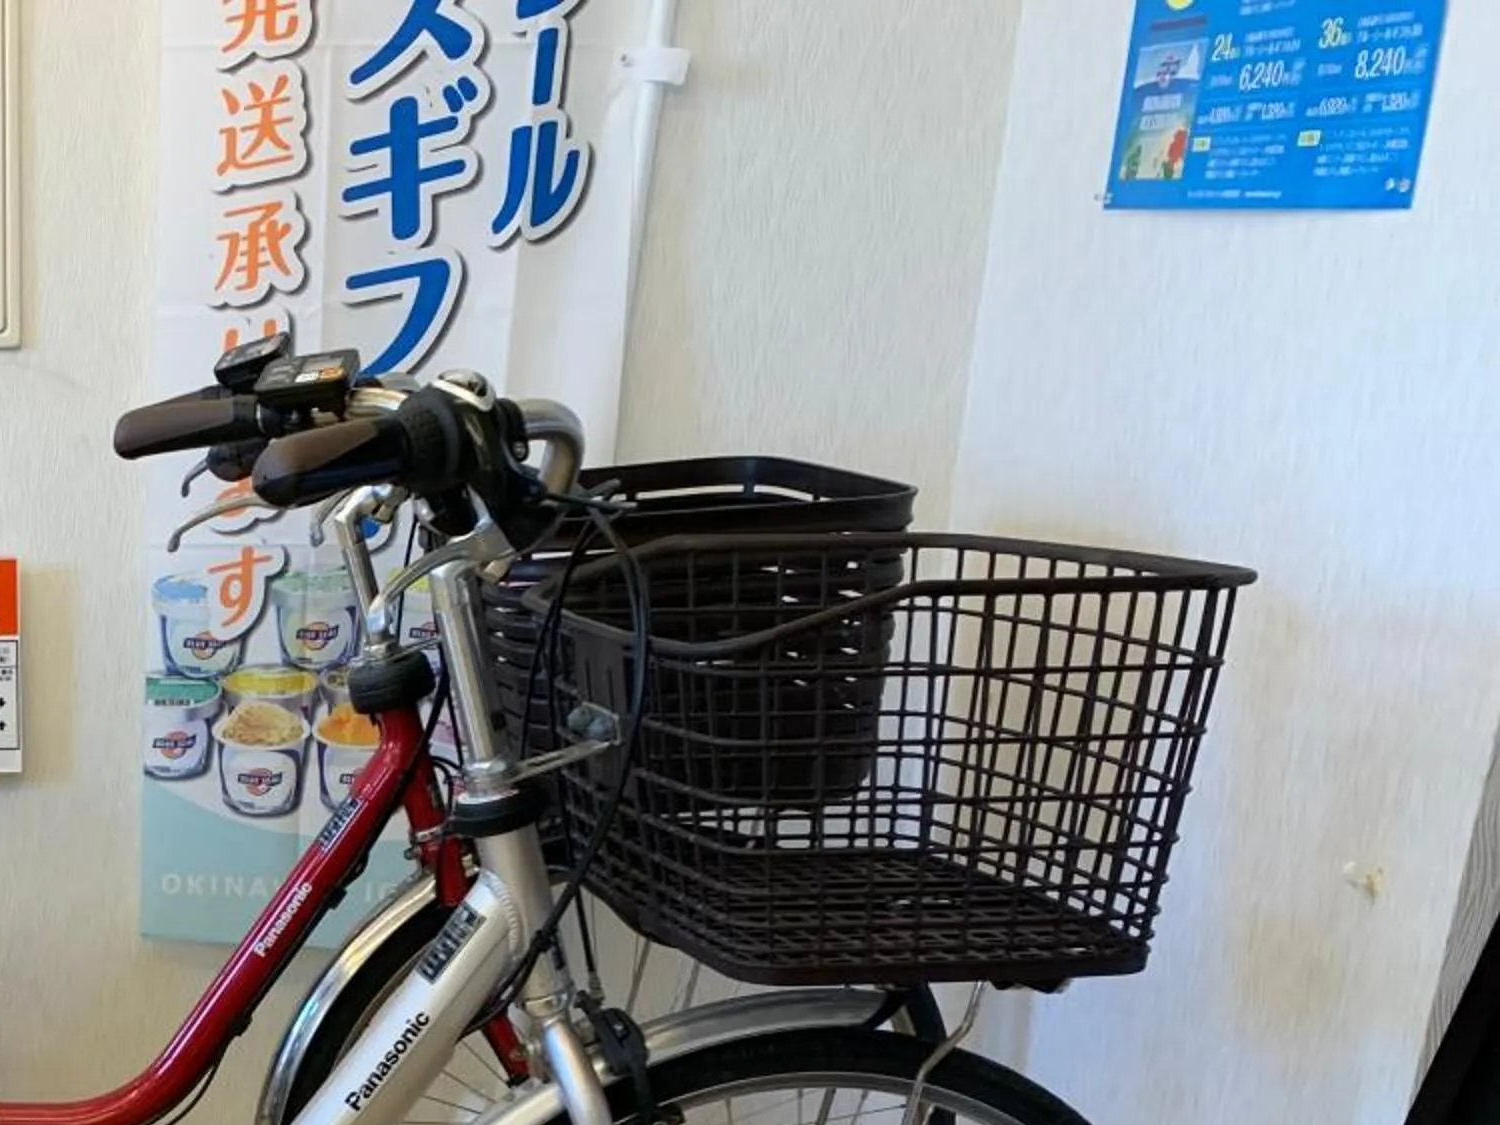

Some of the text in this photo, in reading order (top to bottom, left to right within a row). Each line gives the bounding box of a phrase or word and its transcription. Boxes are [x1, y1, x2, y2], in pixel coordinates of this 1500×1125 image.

[161, 873, 278, 897] OKINA
[253, 882, 313, 958] Panasonic
[344, 1011, 430, 1112] Panasonic
